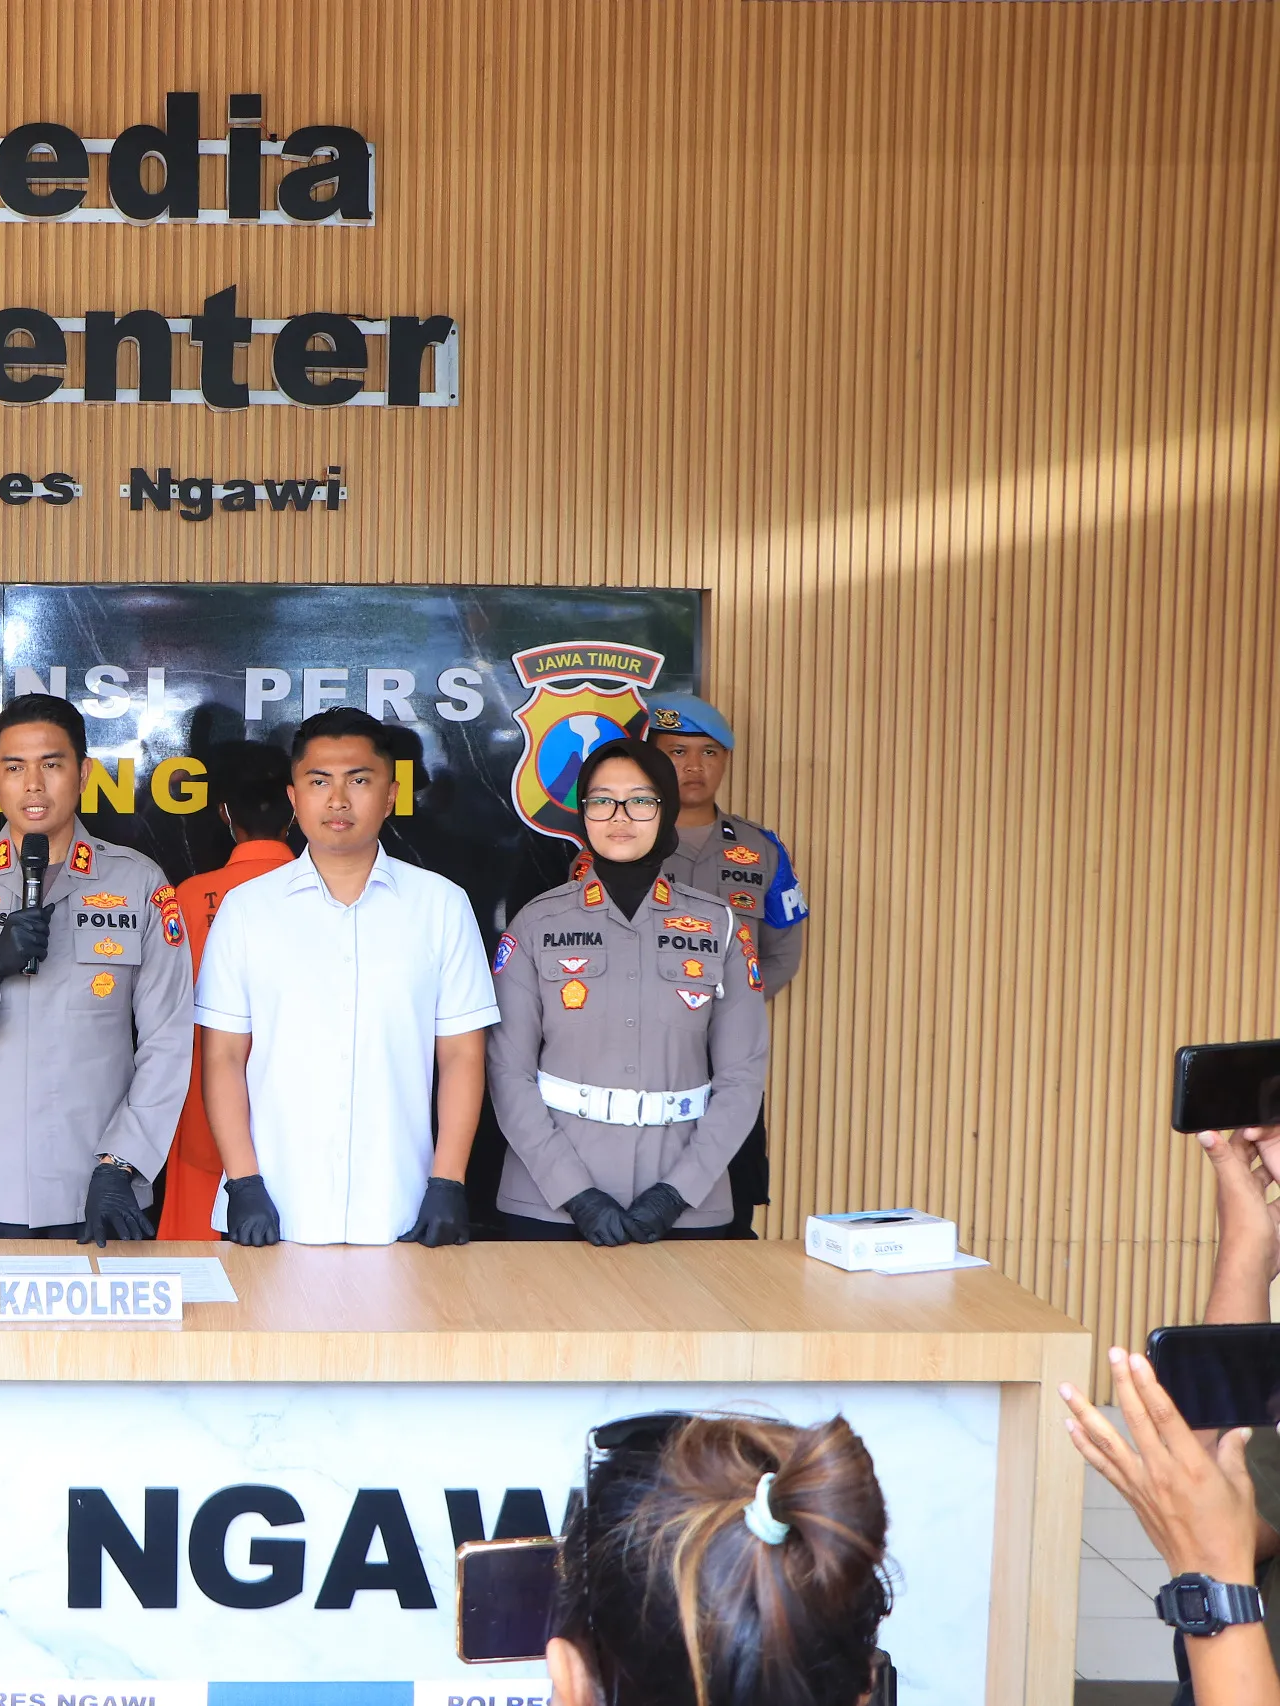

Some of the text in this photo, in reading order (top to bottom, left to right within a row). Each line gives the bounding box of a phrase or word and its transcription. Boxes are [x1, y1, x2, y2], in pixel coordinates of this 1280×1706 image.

[130, 465, 341, 521] Ngawi
[535, 652, 642, 673] JAWA TIMUR
[244, 667, 484, 722] PERS
[722, 869, 763, 886] POLRI
[77, 912, 137, 930] POLRI
[543, 932, 603, 947] PLANTIKA
[658, 935, 718, 953] POLRI
[0, 1280, 172, 1316] KAPOLRES
